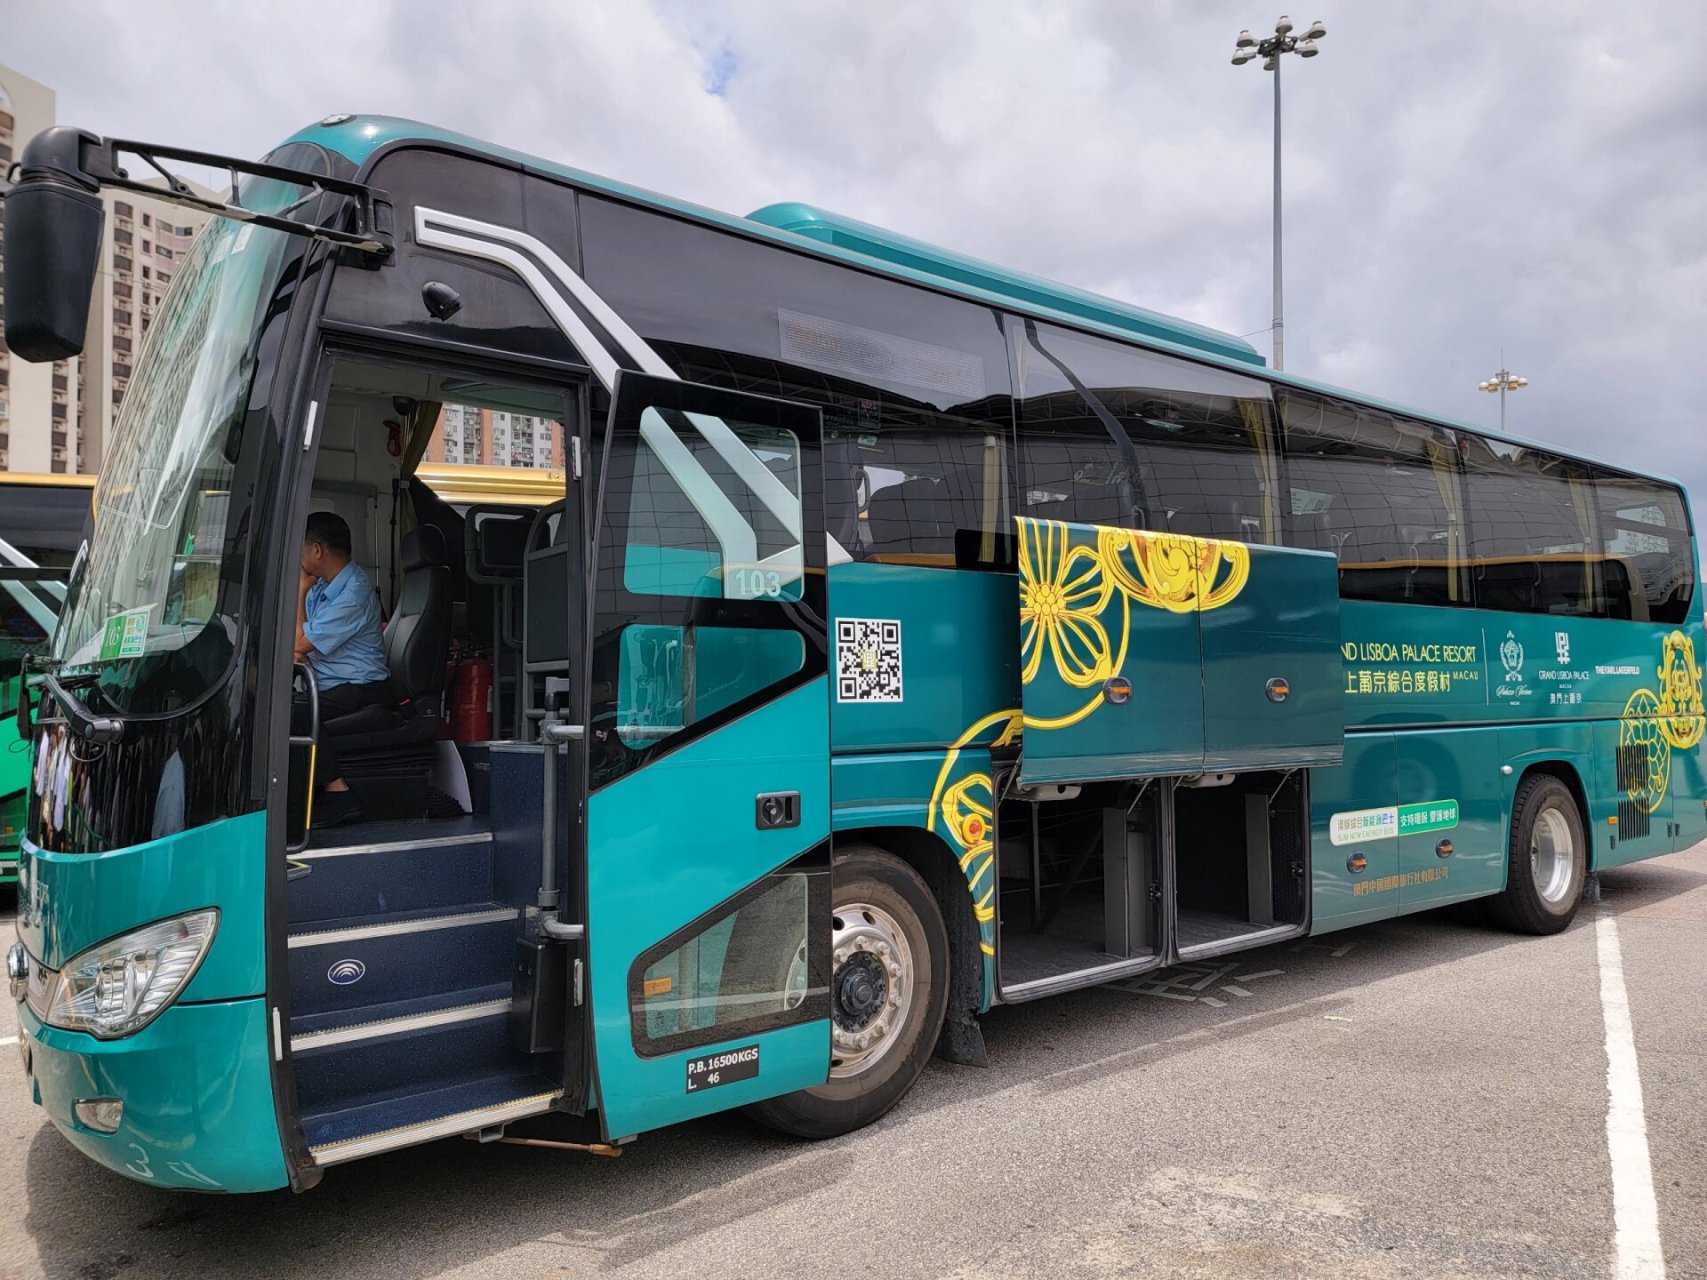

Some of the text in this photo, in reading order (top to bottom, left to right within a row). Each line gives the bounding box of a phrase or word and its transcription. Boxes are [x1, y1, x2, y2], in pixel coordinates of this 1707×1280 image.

[736, 569, 781, 597] 103
[1360, 642, 1400, 661] LISBOA
[1402, 644, 1441, 662] PALACE
[1443, 645, 1476, 662] RESORT
[1453, 671, 1479, 680] MACAU
[1538, 670, 1556, 680] GRAND
[688, 1071, 720, 1090] L. 46
